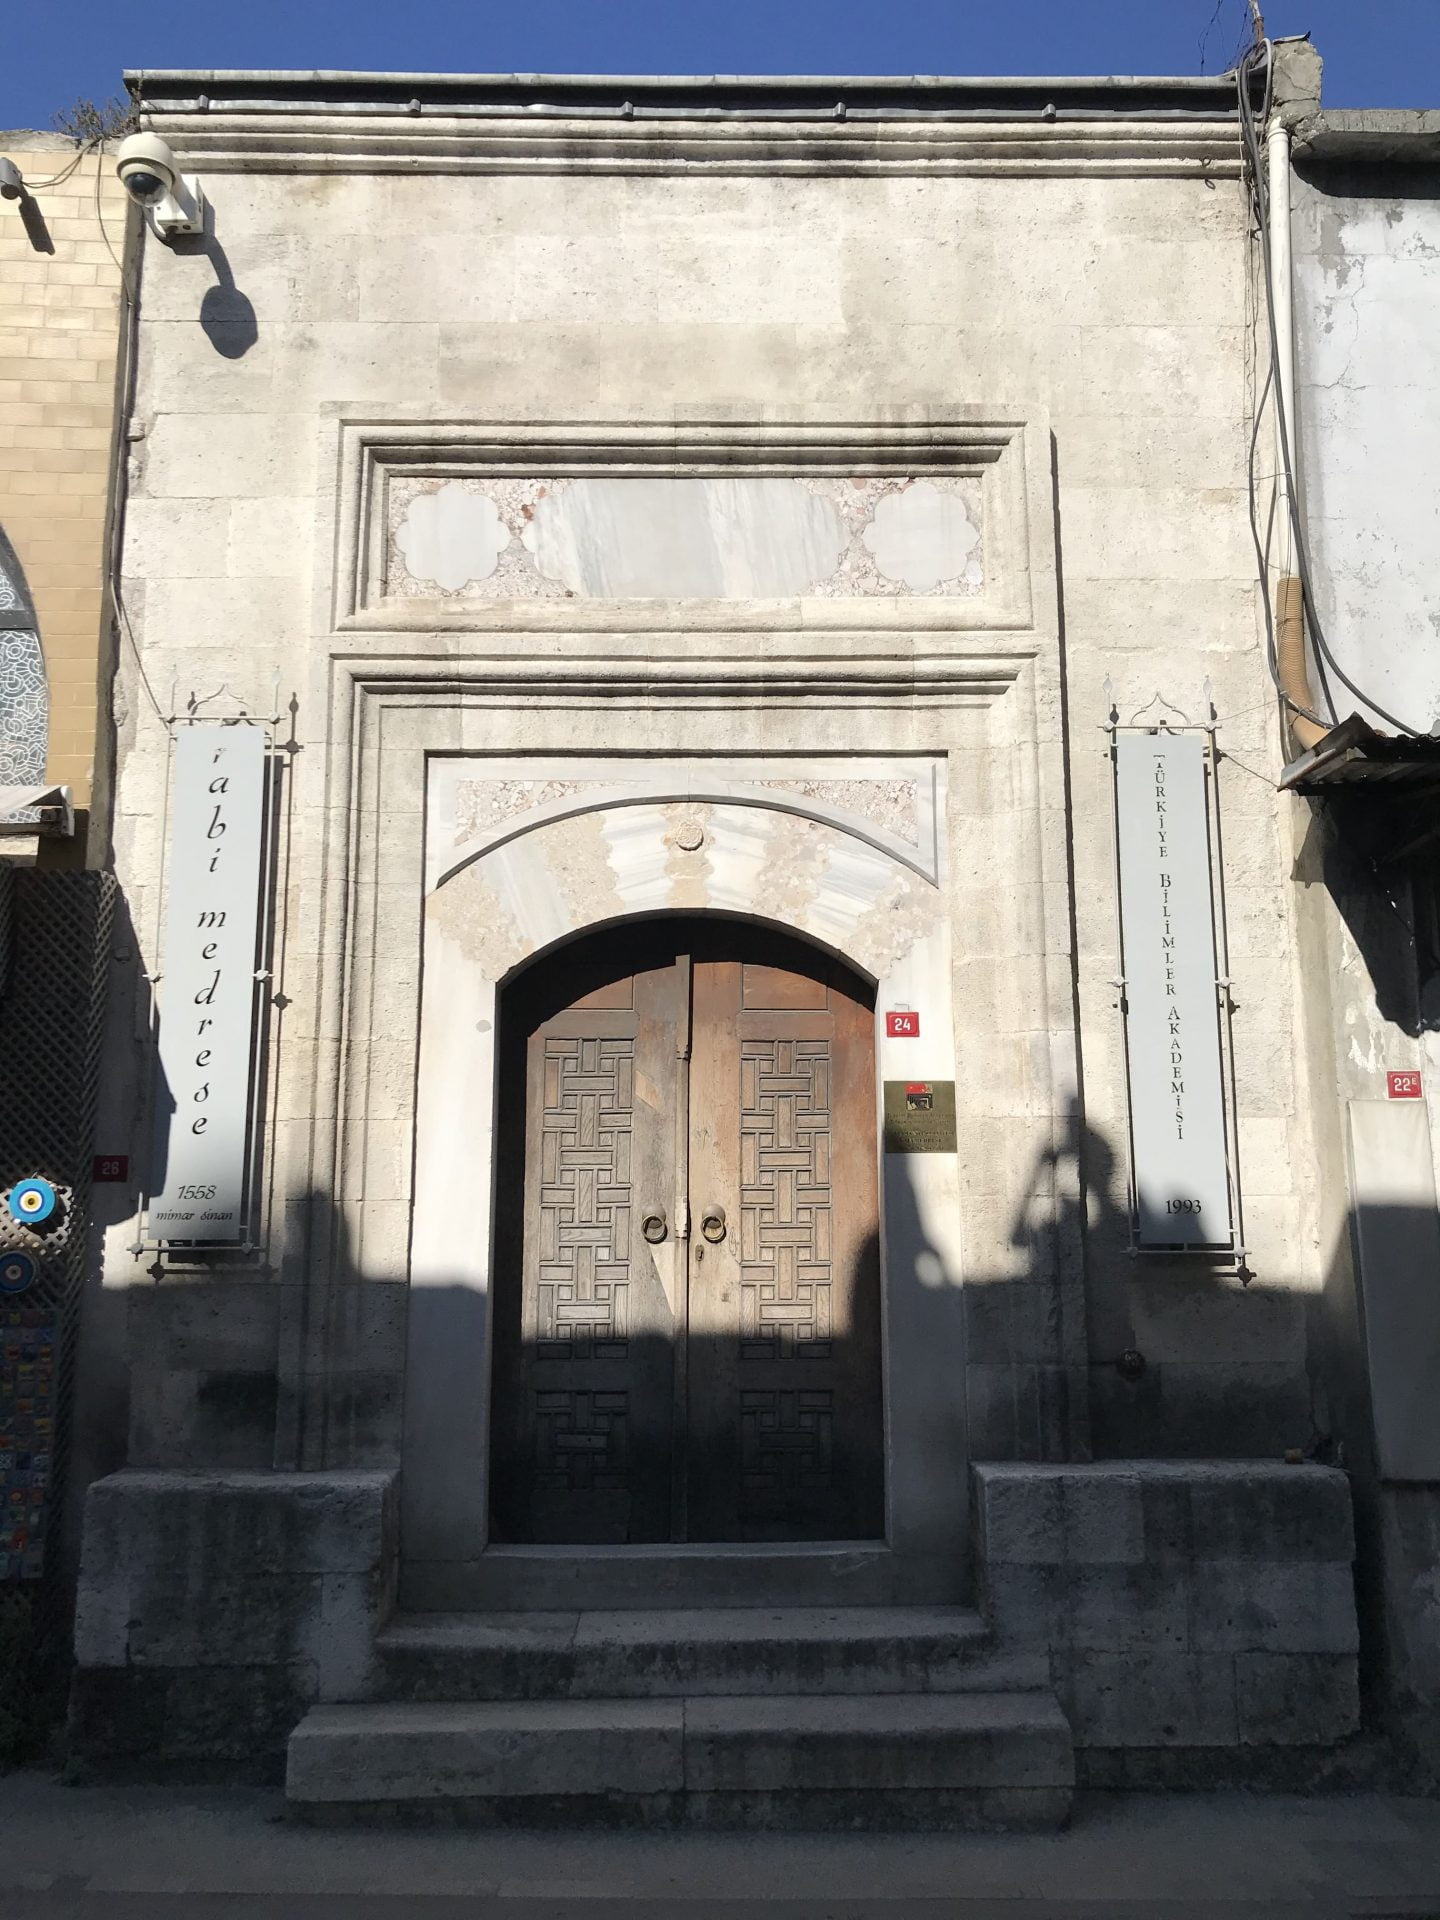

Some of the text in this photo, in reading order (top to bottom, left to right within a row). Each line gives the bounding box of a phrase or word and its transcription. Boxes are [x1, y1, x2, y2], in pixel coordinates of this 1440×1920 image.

[1153, 754, 1185, 1140] TÜRKİYE BİLİMLER AKADEMİSİ
[192, 911, 227, 1135] medrese
[894, 1017, 911, 1031] 24
[101, 1161, 120, 1175] 26
[177, 1185, 217, 1200] 1558
[1165, 1199, 1202, 1214] 1993
[155, 1208, 233, 1221] mimar sinan
